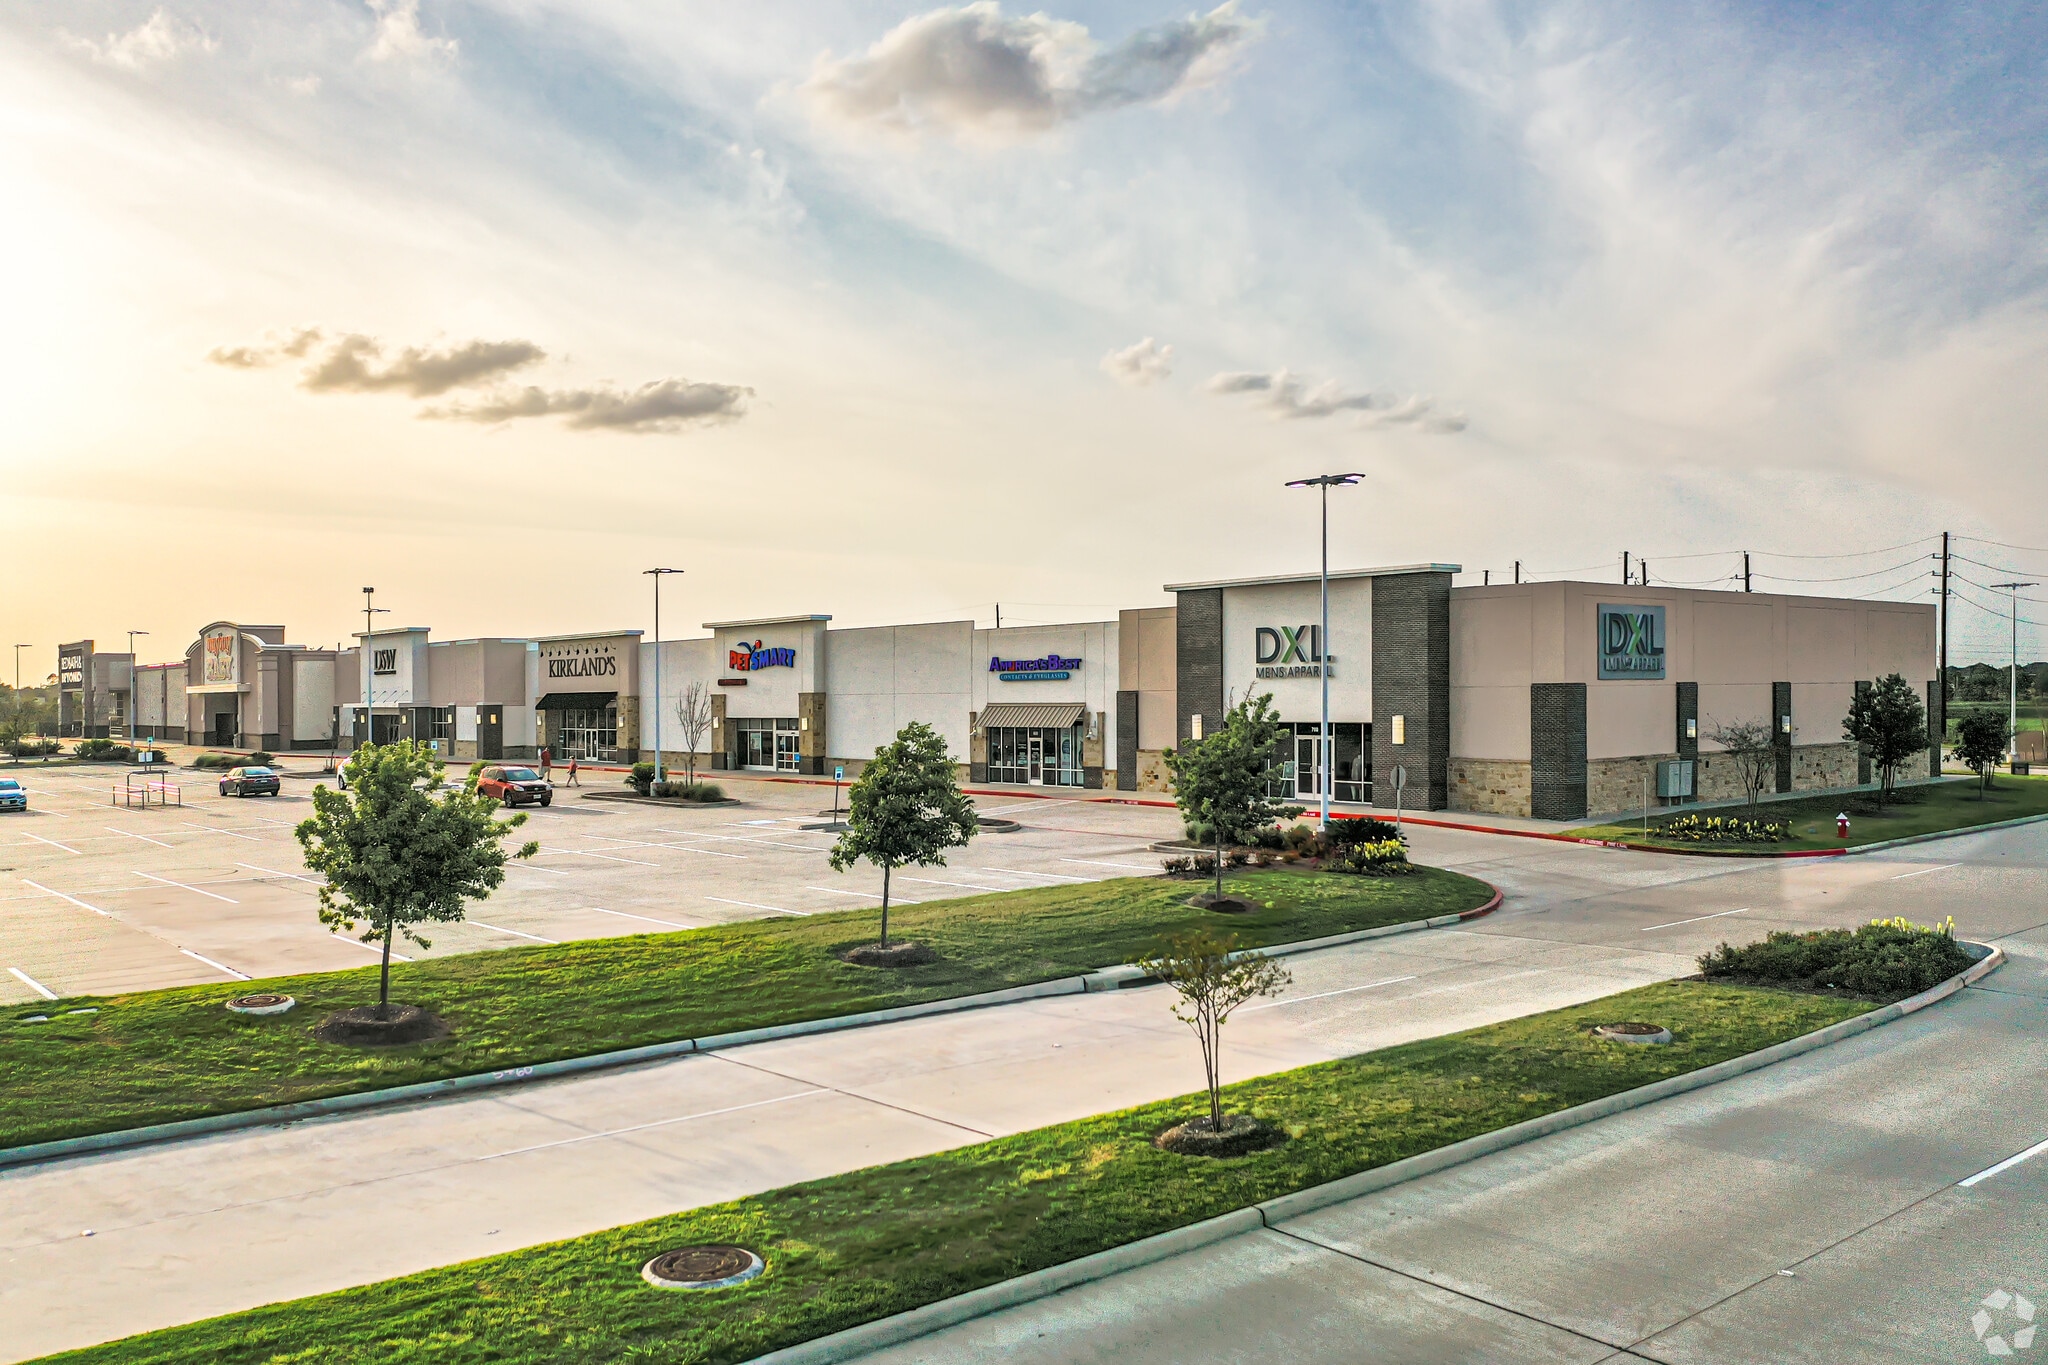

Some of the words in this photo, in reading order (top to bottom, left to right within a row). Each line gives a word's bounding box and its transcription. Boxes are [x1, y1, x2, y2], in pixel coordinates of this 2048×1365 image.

[1256, 625, 1333, 664] DXL
[1604, 613, 1664, 655] DXL
[374, 648, 397, 670] DSW
[549, 656, 616, 677] KIRKLAND'S
[1256, 667, 1285, 678] MENS
[1287, 665, 1334, 678] APPARL
